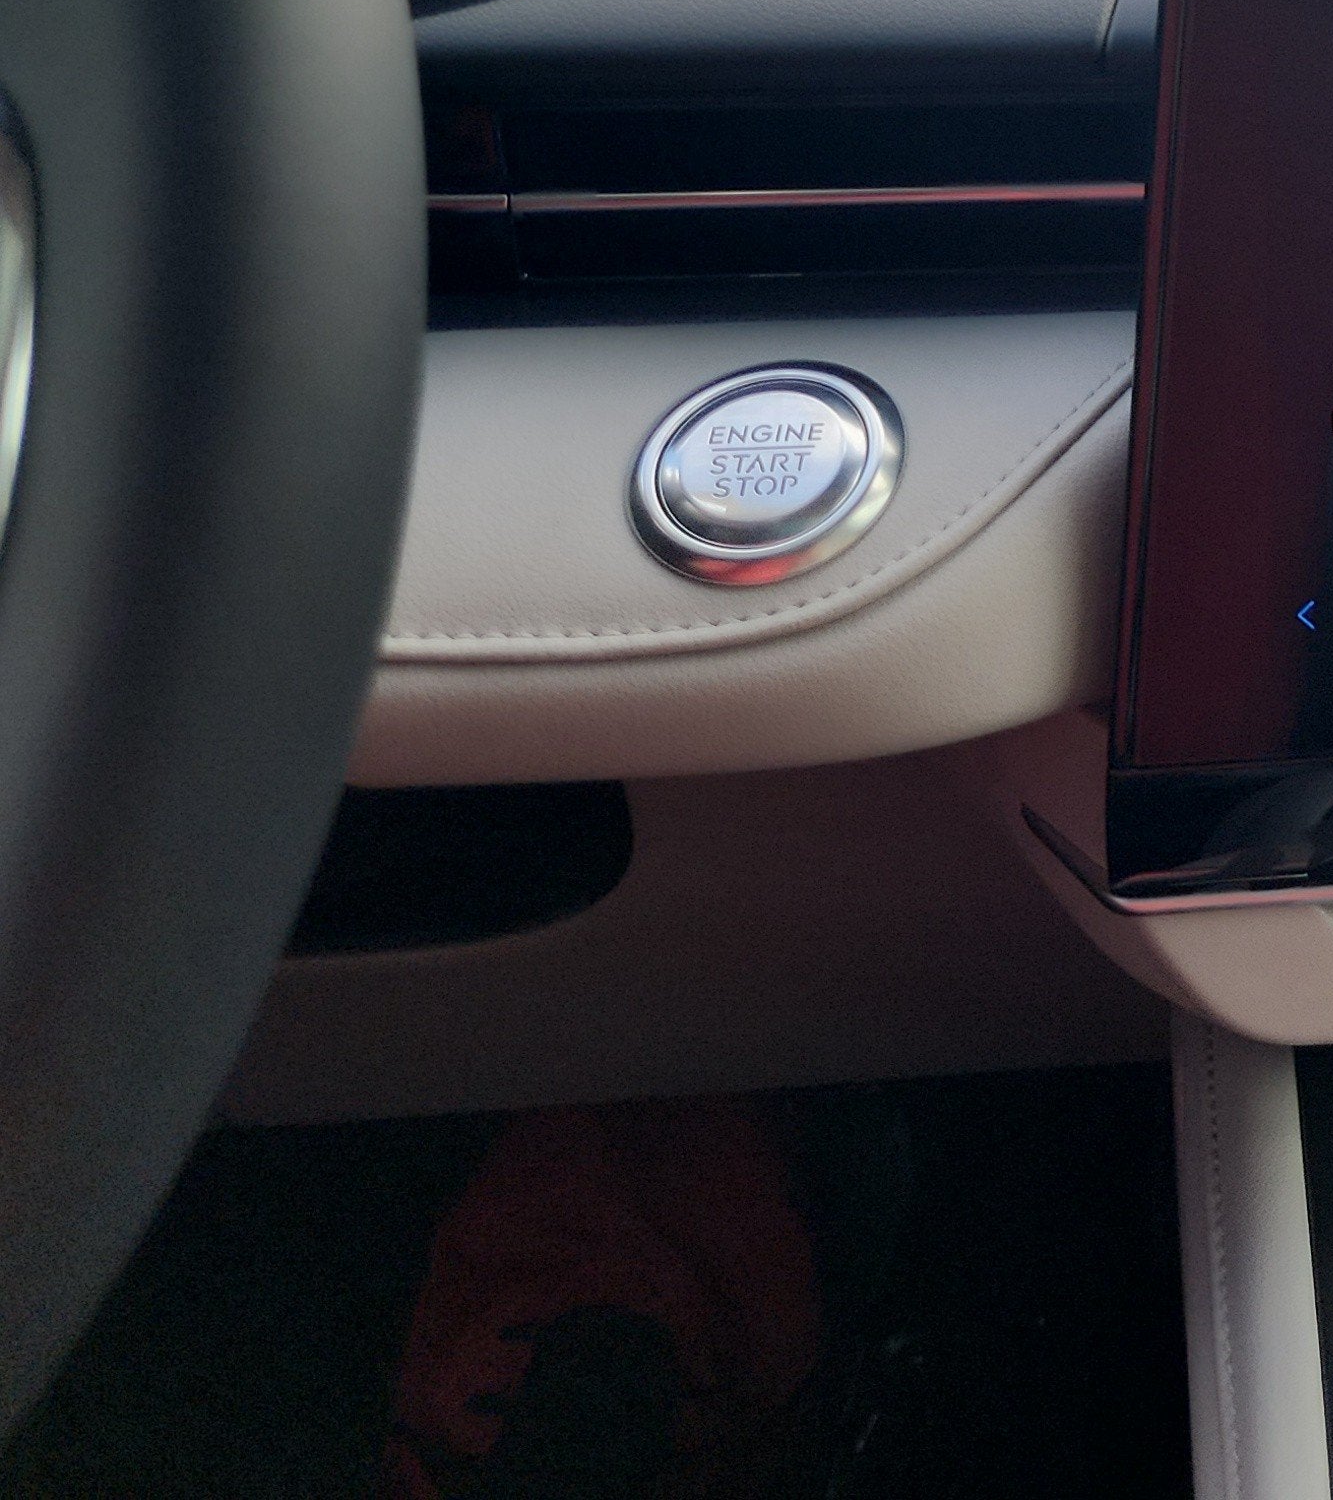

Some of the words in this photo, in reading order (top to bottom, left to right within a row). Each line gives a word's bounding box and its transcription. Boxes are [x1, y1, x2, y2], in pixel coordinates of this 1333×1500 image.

[708, 422, 826, 446] ENGINE
[709, 451, 813, 475] START
[712, 474, 799, 499] STOP
